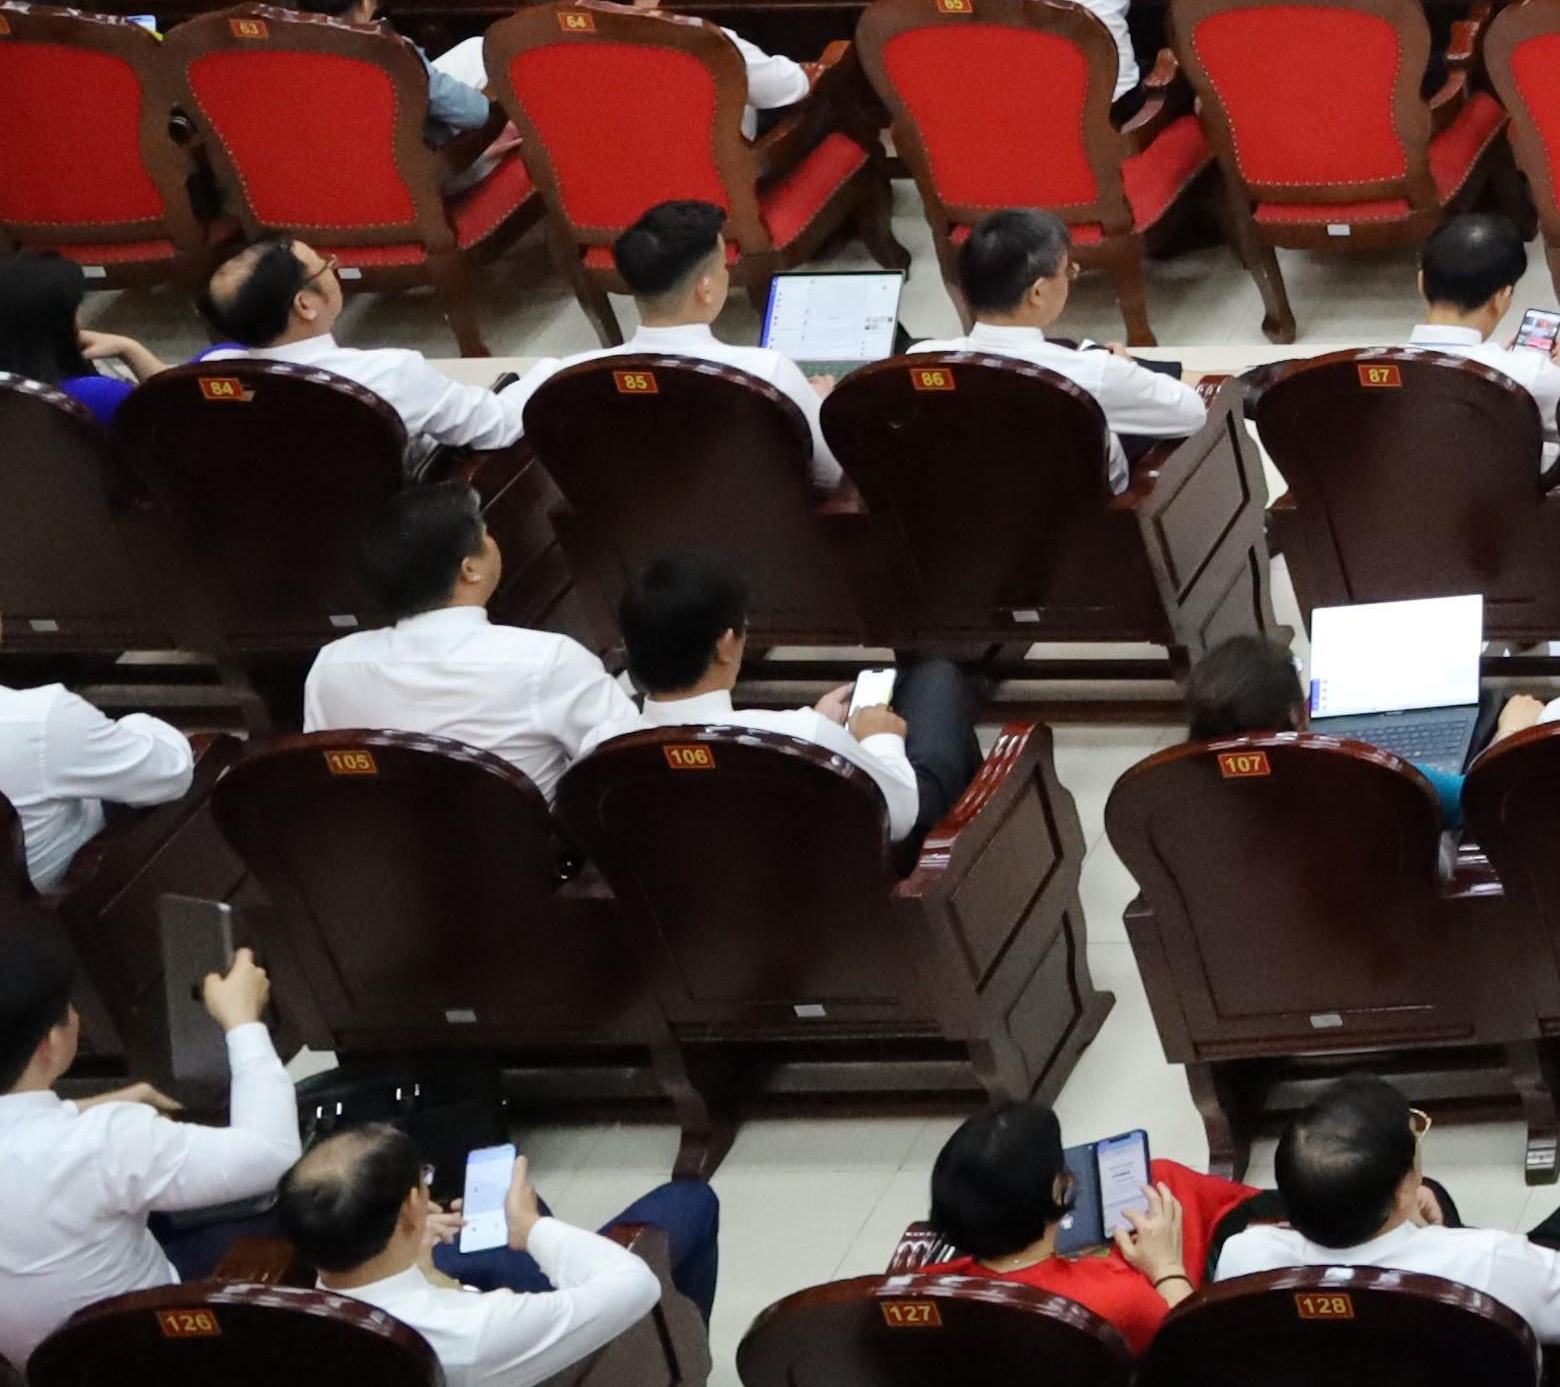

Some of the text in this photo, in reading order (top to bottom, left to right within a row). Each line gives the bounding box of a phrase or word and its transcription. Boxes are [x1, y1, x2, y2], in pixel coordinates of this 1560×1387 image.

[623, 374, 648, 390] 85
[1368, 368, 1390, 383] 87
[331, 754, 370, 770] 105
[1225, 755, 1261, 773] 107
[889, 1305, 931, 1322] 127
